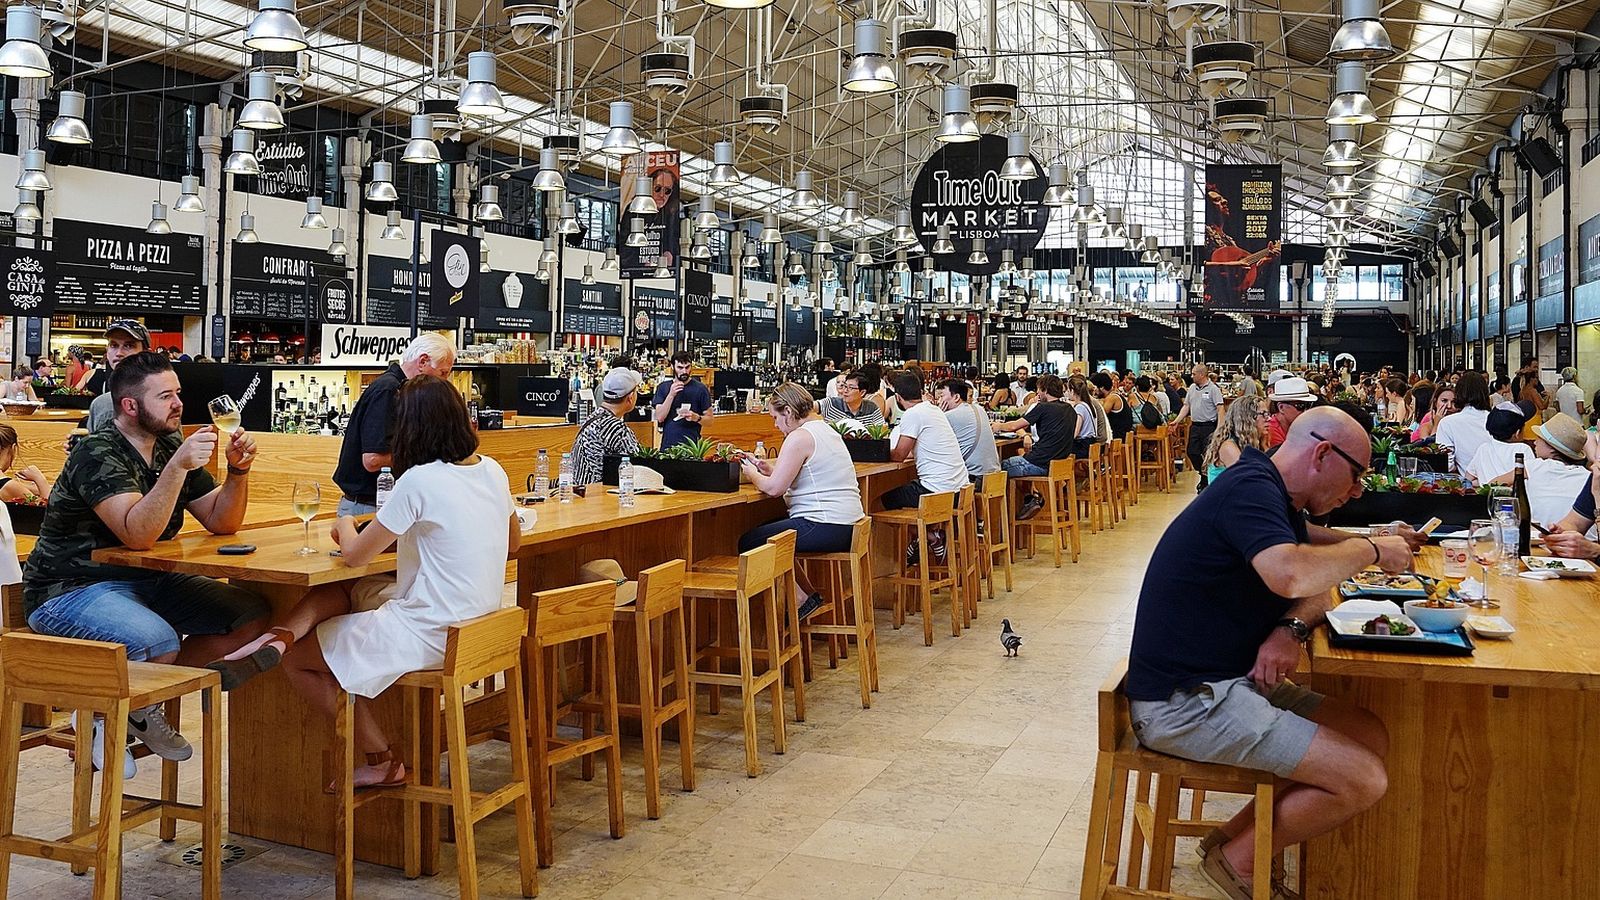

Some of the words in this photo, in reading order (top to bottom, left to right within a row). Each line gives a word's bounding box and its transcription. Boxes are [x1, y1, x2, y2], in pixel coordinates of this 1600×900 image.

[255, 140, 305, 161] Estúdio
[257, 164, 286, 194] Time
[286, 164, 309, 193] Out
[934, 170, 982, 206] Time
[983, 170, 1022, 205] Out
[922, 210, 1037, 227] MARKET
[959, 230, 1000, 239] LISBOA
[87, 238, 122, 260] PIZZA
[126, 242, 134, 261] A
[139, 243, 170, 264] PEZZI
[7, 272, 37, 284] CASA
[393, 269, 431, 288] HONOATO
[7, 282, 44, 294] GINJA
[327, 288, 346, 299] FRUTOS
[327, 298, 346, 310] SECOS
[687, 294, 710, 307] CINCO
[1010, 321, 1053, 331] MANTEIGARIA
[330, 327, 411, 361] Schweppes
[236, 372, 261, 413] hweppes
[525, 391, 557, 401] CINCO
